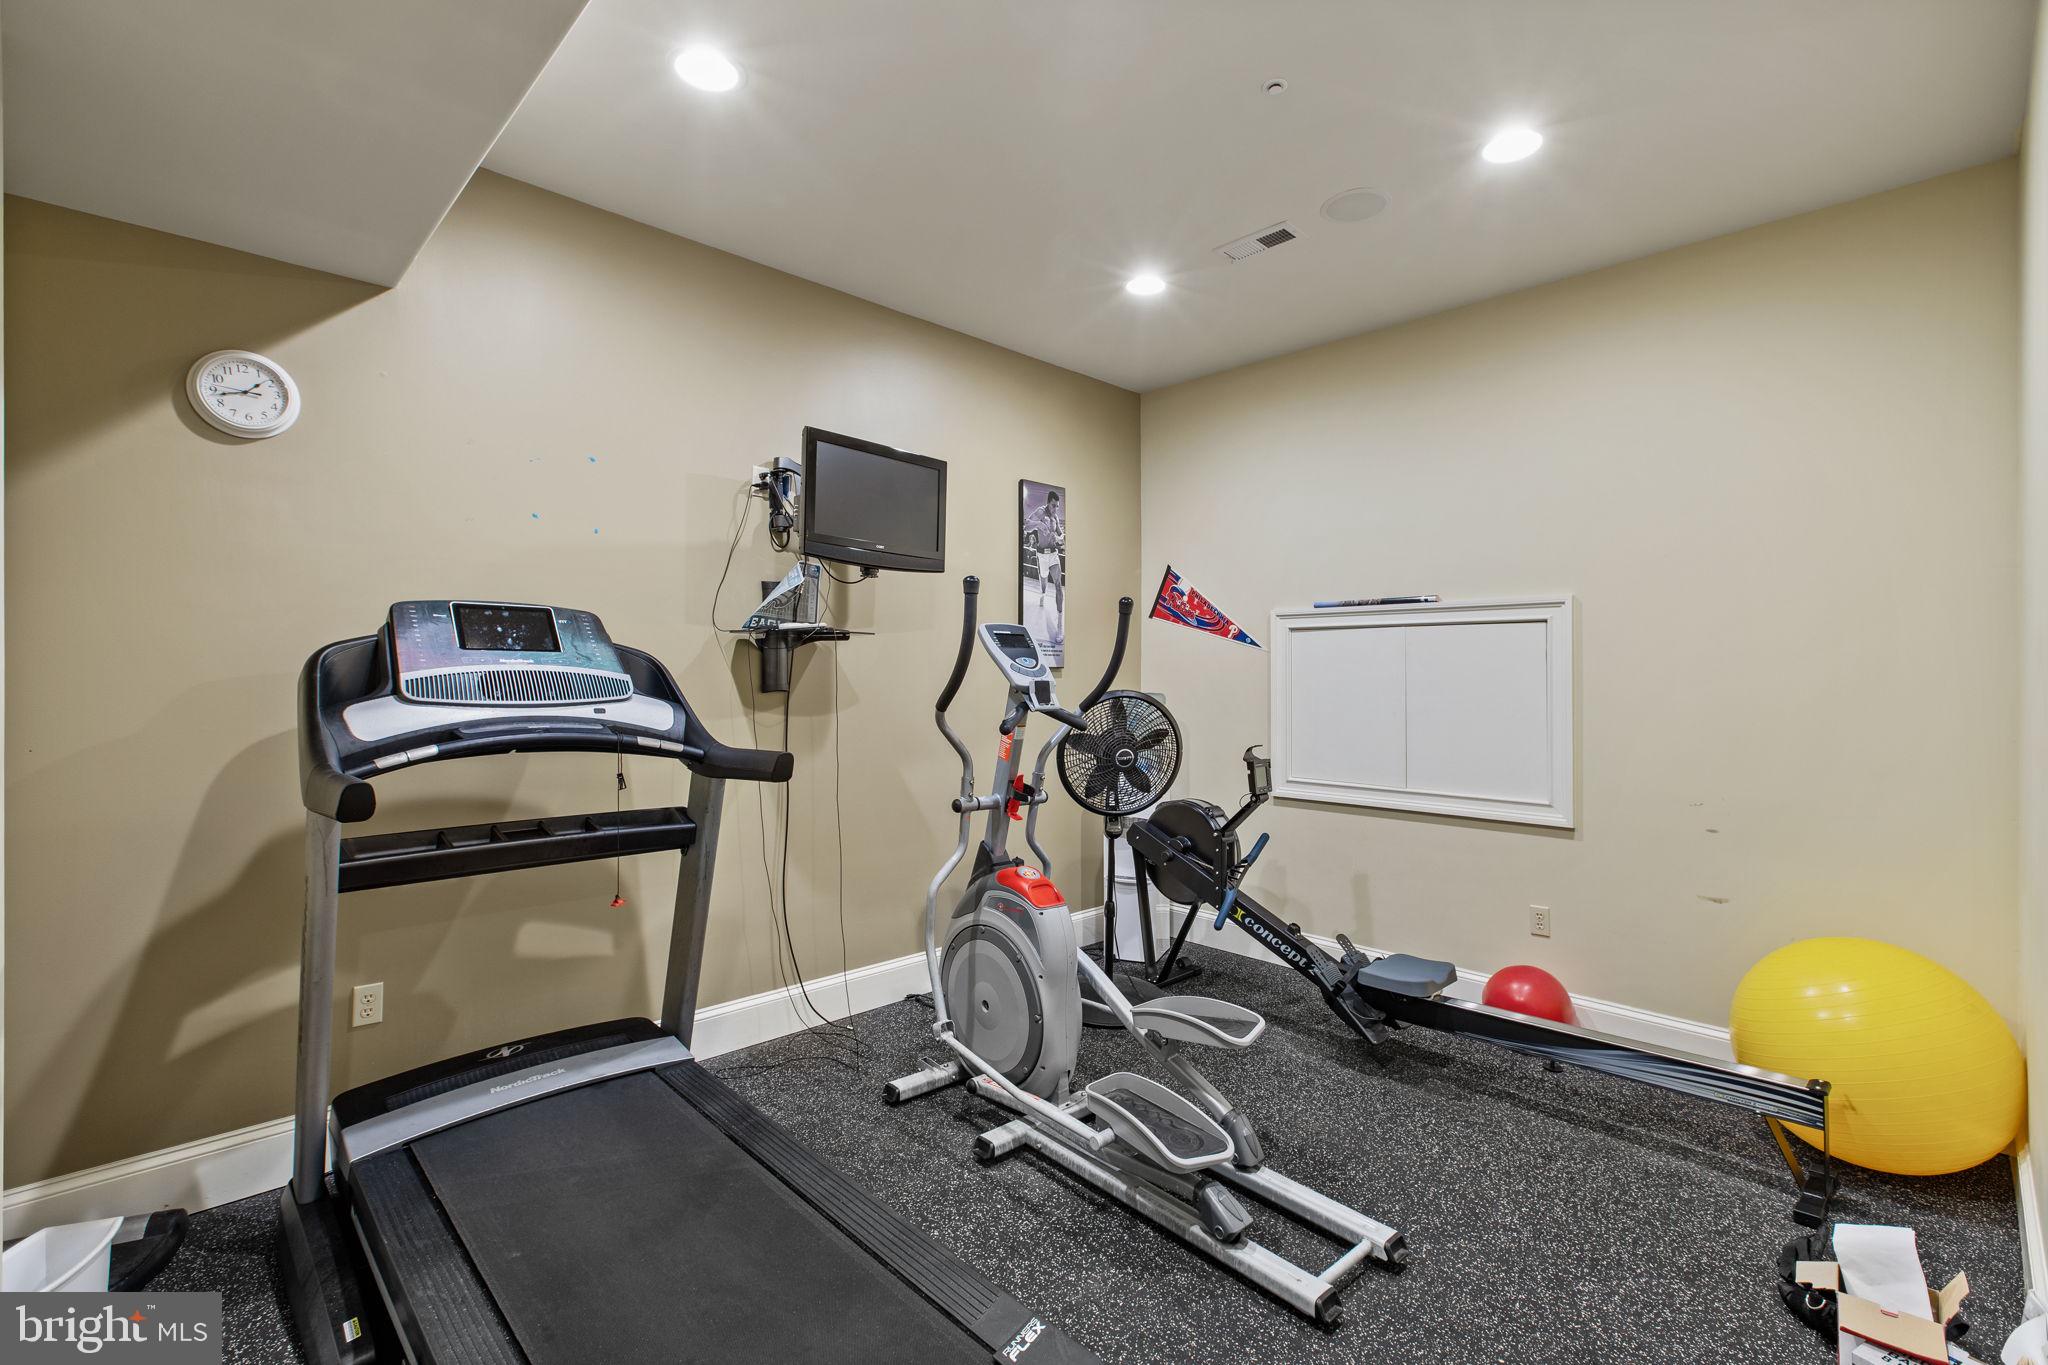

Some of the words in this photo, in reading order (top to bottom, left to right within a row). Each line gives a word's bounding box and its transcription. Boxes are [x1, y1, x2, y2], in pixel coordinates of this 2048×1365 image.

[222, 366, 233, 376] 11
[236, 364, 249, 374] 12
[256, 369, 261, 378] 1
[212, 374, 224, 383] 10
[268, 379, 275, 388] 2
[209, 385, 218, 394] 9
[274, 391, 281, 399] 3
[216, 398, 225, 408] 8
[270, 403, 278, 411] 4
[229, 408, 237, 417] 7
[245, 413, 253, 421] 6
[261, 411, 268, 420] 5
[1244, 917, 1308, 967] concept
[489, 1068, 566, 1094] NordicTrack
[1002, 1317, 1040, 1357] RUNNERS
[1009, 1321, 1047, 1362] FLEX
